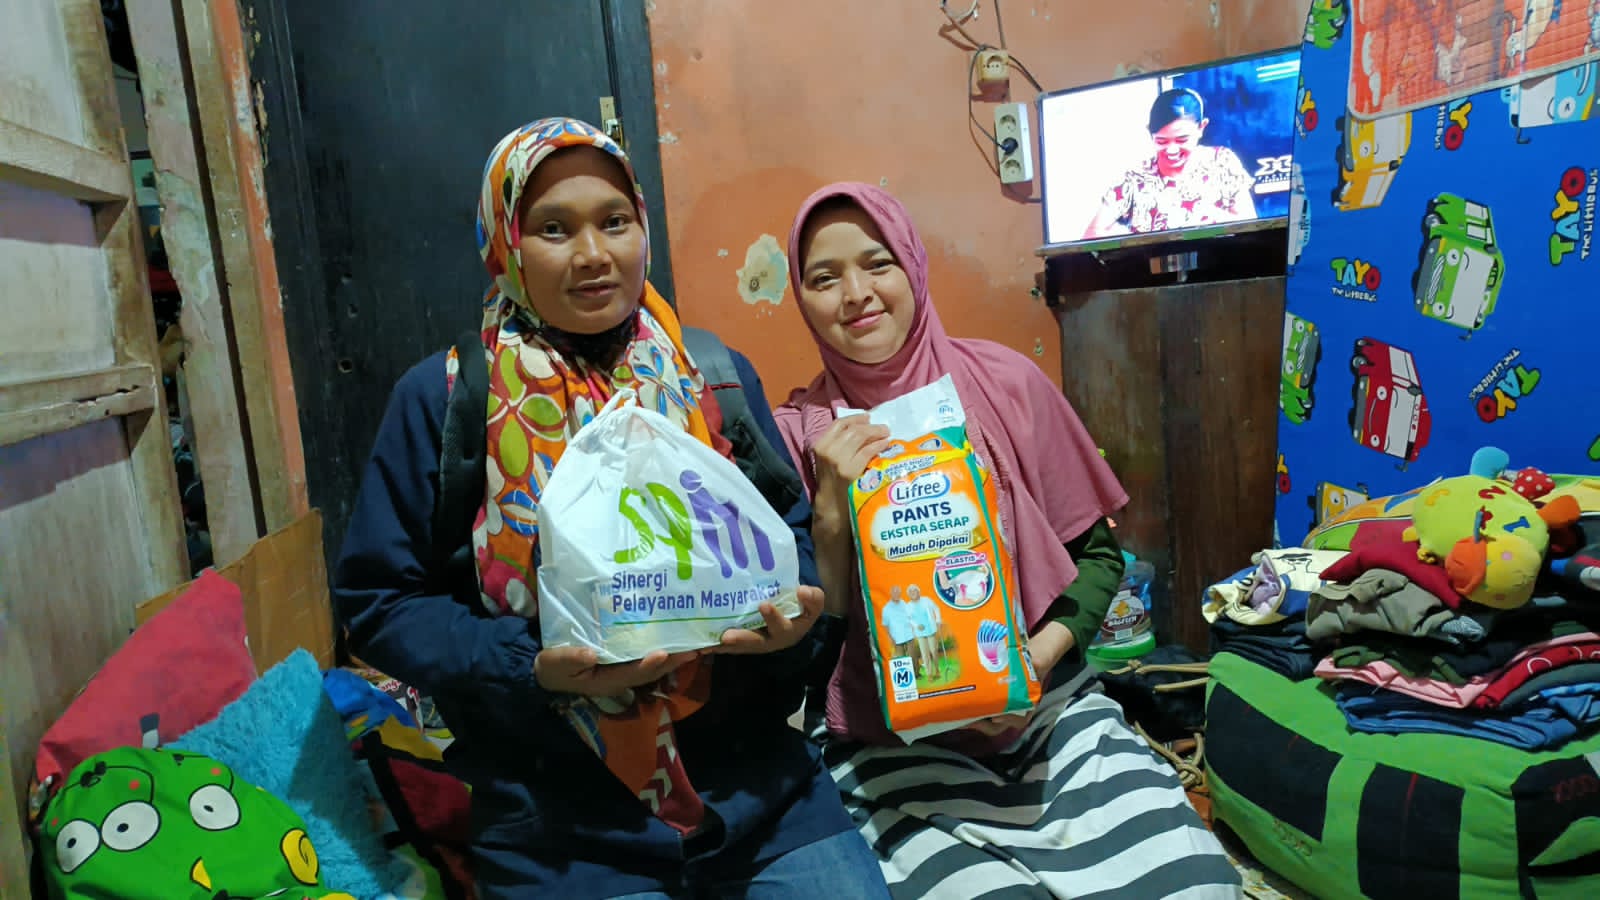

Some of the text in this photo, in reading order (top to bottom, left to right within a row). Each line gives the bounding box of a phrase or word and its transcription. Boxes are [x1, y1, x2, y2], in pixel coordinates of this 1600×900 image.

[1550, 167, 1586, 264] TAYO
[1331, 258, 1381, 291] TAYO
[1477, 365, 1540, 423] TAYO
[896, 481, 941, 501] Lifree
[892, 501, 952, 525] PANTS
[880, 516, 970, 541] EKSTRA SERAP
[889, 533, 969, 557] Mudah Dipakai
[945, 555, 977, 565] ELASTIS
[612, 569, 668, 591] Sinergi
[613, 580, 781, 615] Pelayanan Masyarakat
[895, 671, 909, 684] M
